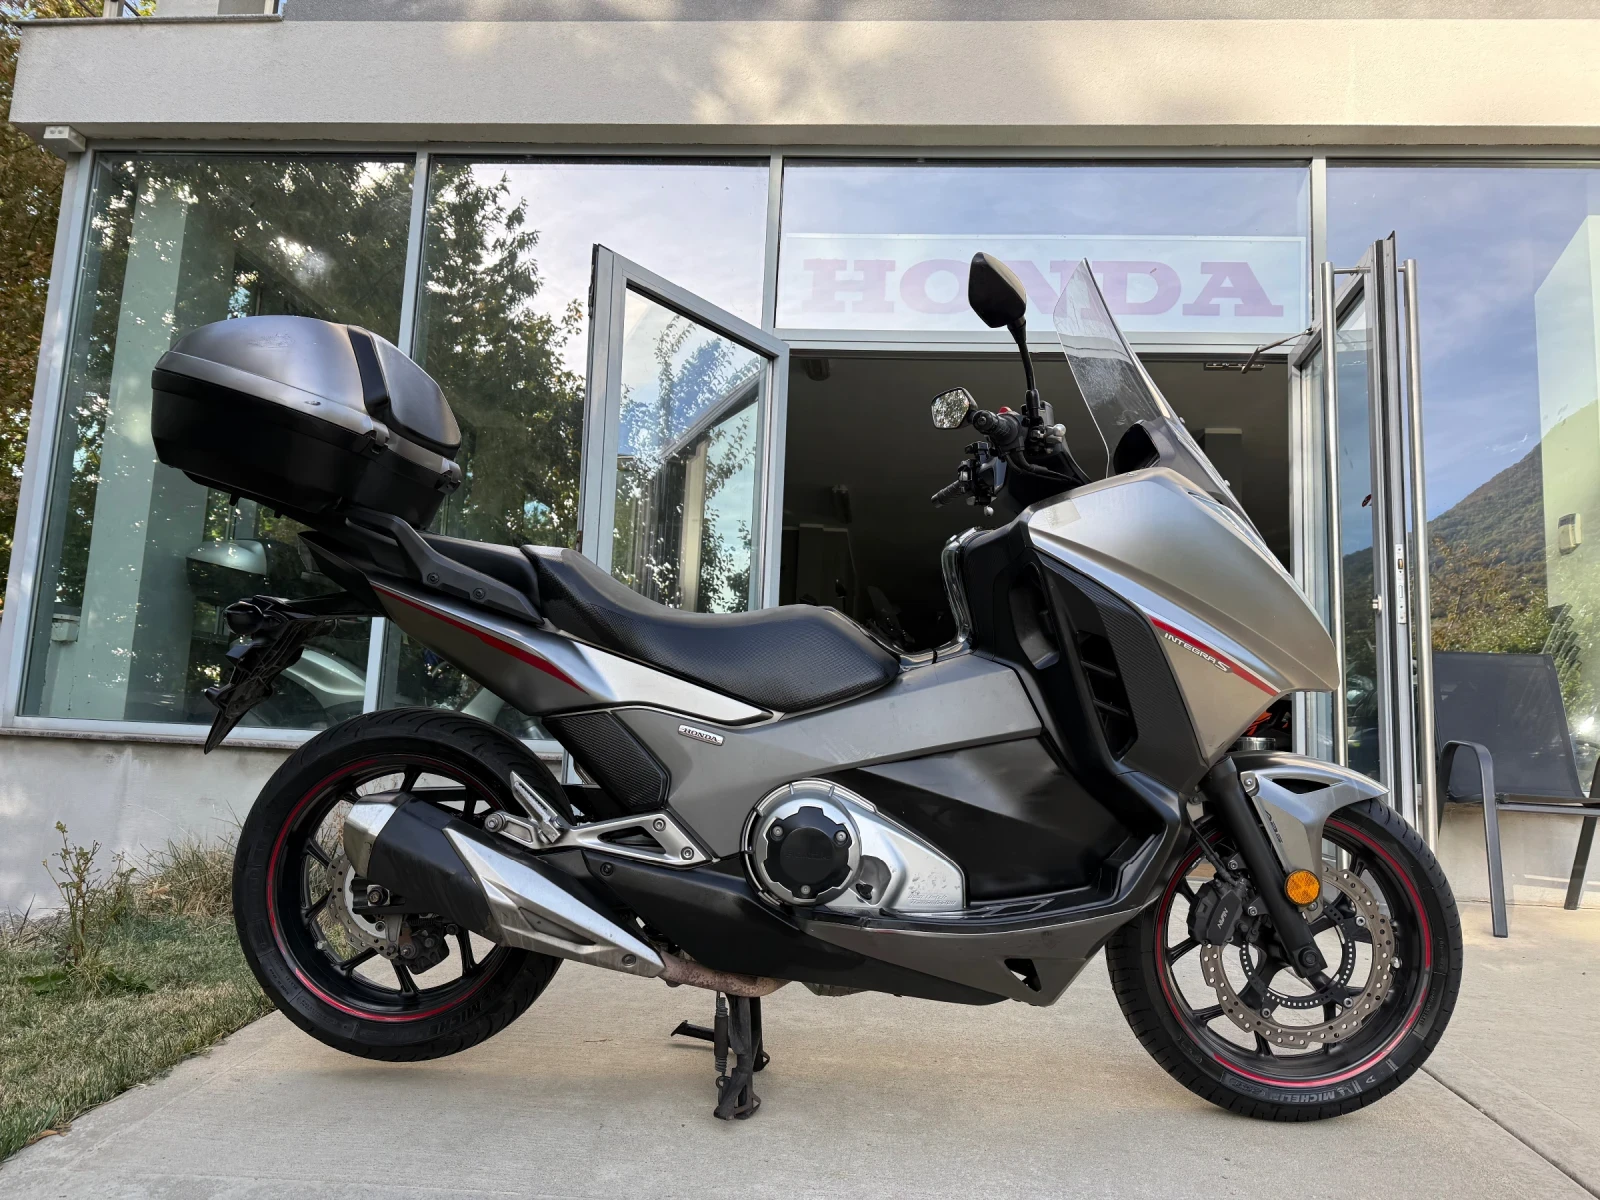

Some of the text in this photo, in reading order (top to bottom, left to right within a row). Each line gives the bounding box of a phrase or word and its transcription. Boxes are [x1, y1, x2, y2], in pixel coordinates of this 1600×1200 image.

[803, 258, 1284, 317] HONDA
[1163, 632, 1217, 663] INTEGRA
[682, 727, 719, 742] HONDA
[1269, 1090, 1336, 1103] MICHELIN
